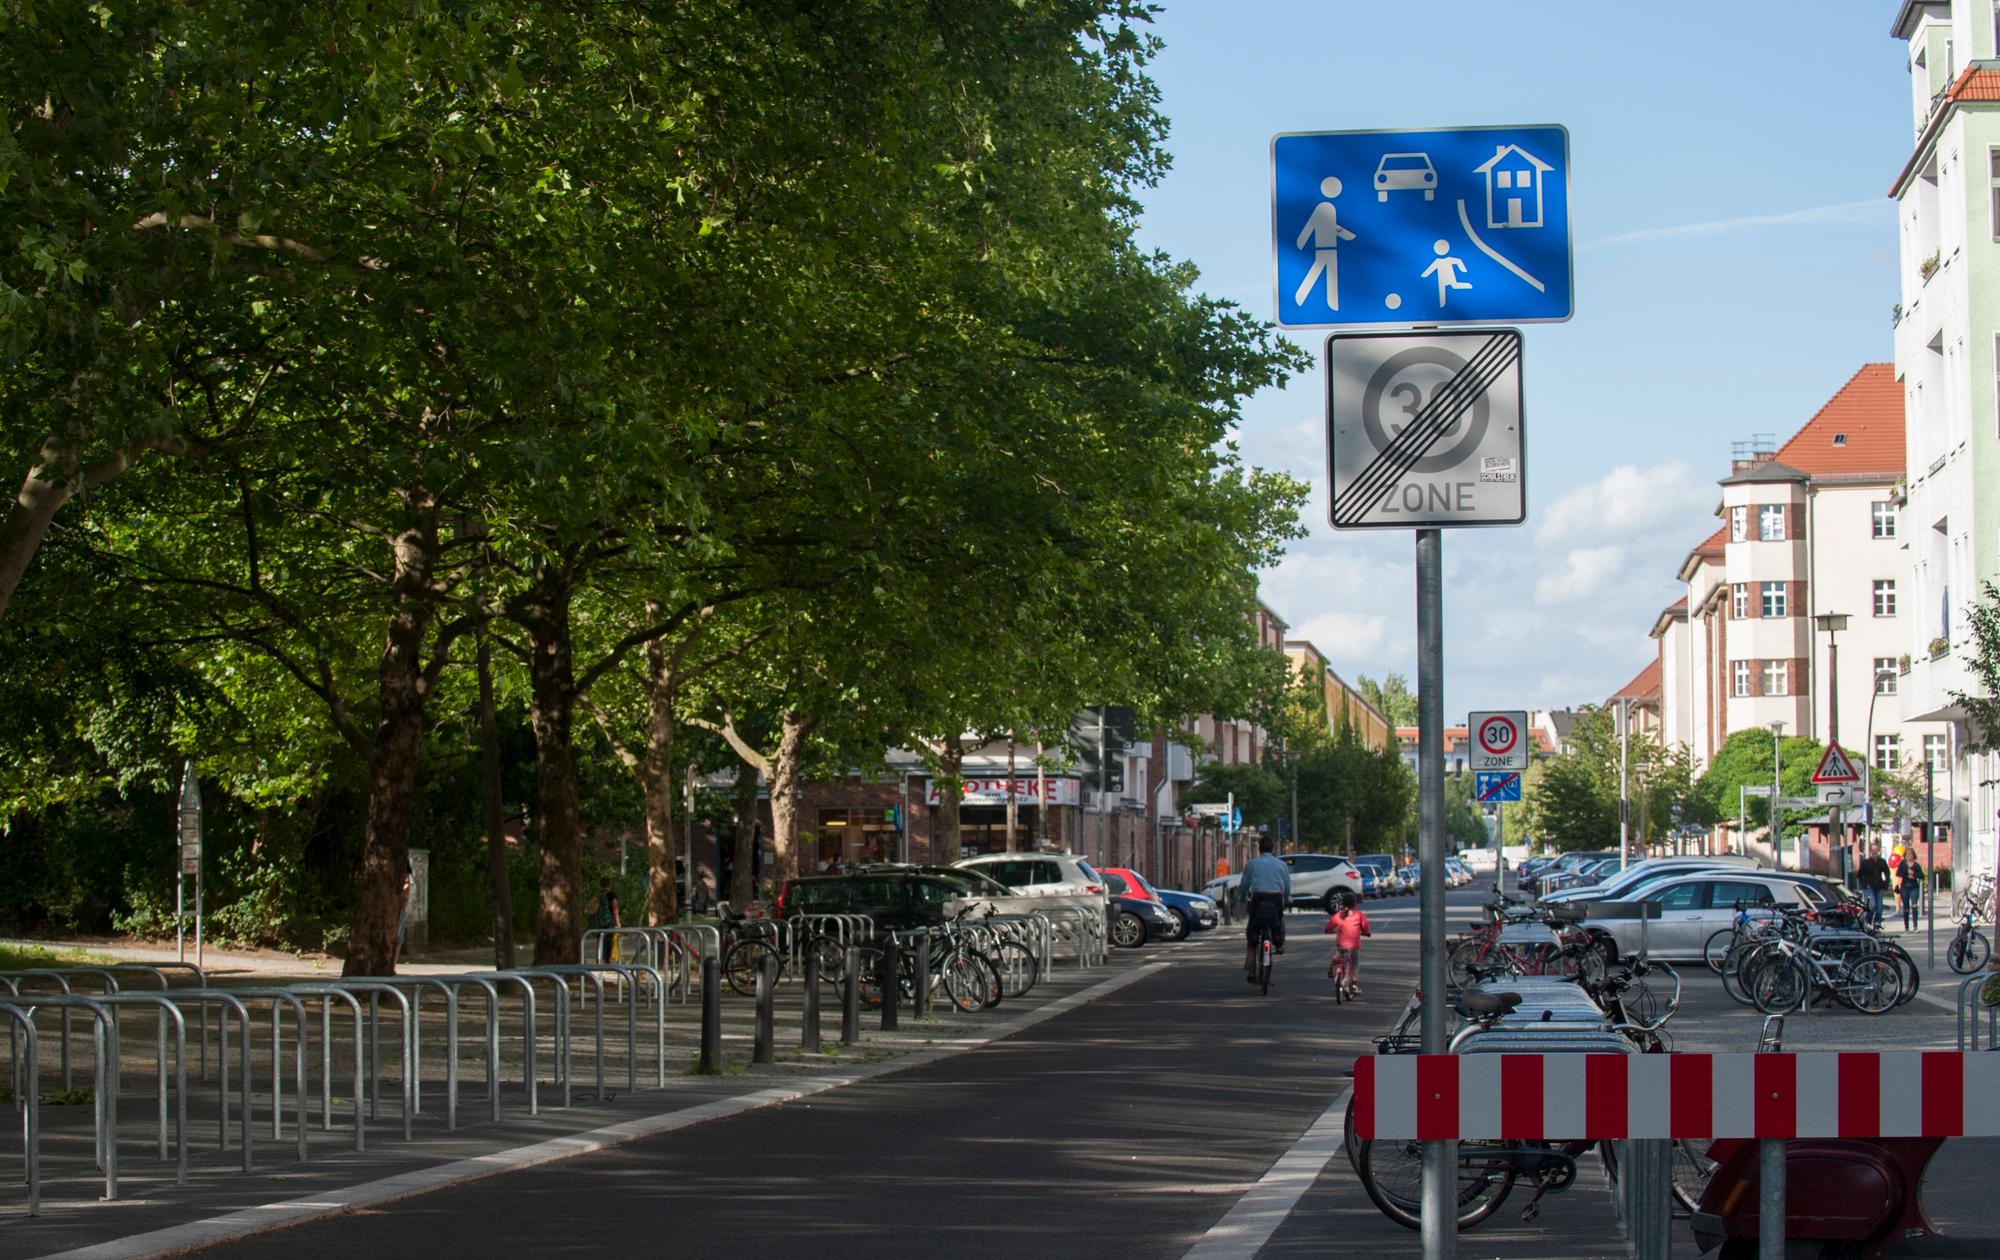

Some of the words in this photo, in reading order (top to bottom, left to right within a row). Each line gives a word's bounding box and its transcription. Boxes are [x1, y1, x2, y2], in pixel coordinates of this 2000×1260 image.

[1390, 382, 1462, 438] 30
[1381, 482, 1476, 513] ZONE
[1487, 726, 1510, 744] 30
[1484, 756, 1513, 767] ZONE
[929, 779, 1057, 801] AOTHEKE
